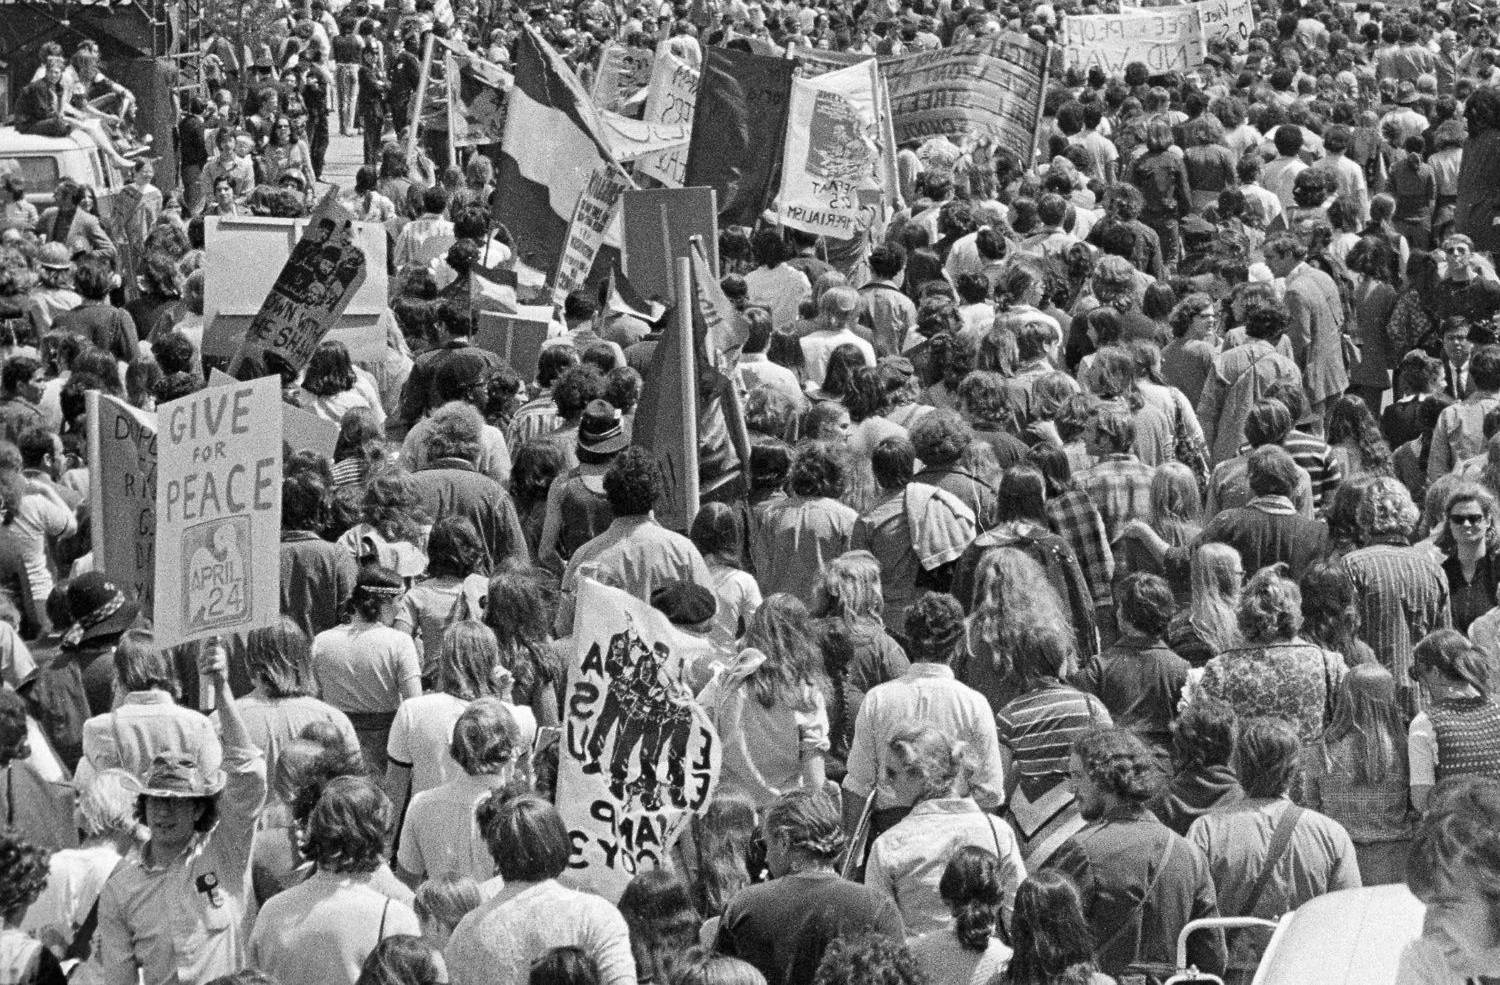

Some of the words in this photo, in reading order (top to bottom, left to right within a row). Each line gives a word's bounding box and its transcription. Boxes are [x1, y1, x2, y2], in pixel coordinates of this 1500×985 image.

[170, 388, 254, 445] GIVE
[193, 441, 227, 464] FOR
[166, 457, 276, 523] PEACE
[191, 561, 242, 591] APRIL
[208, 583, 244, 616] 24
